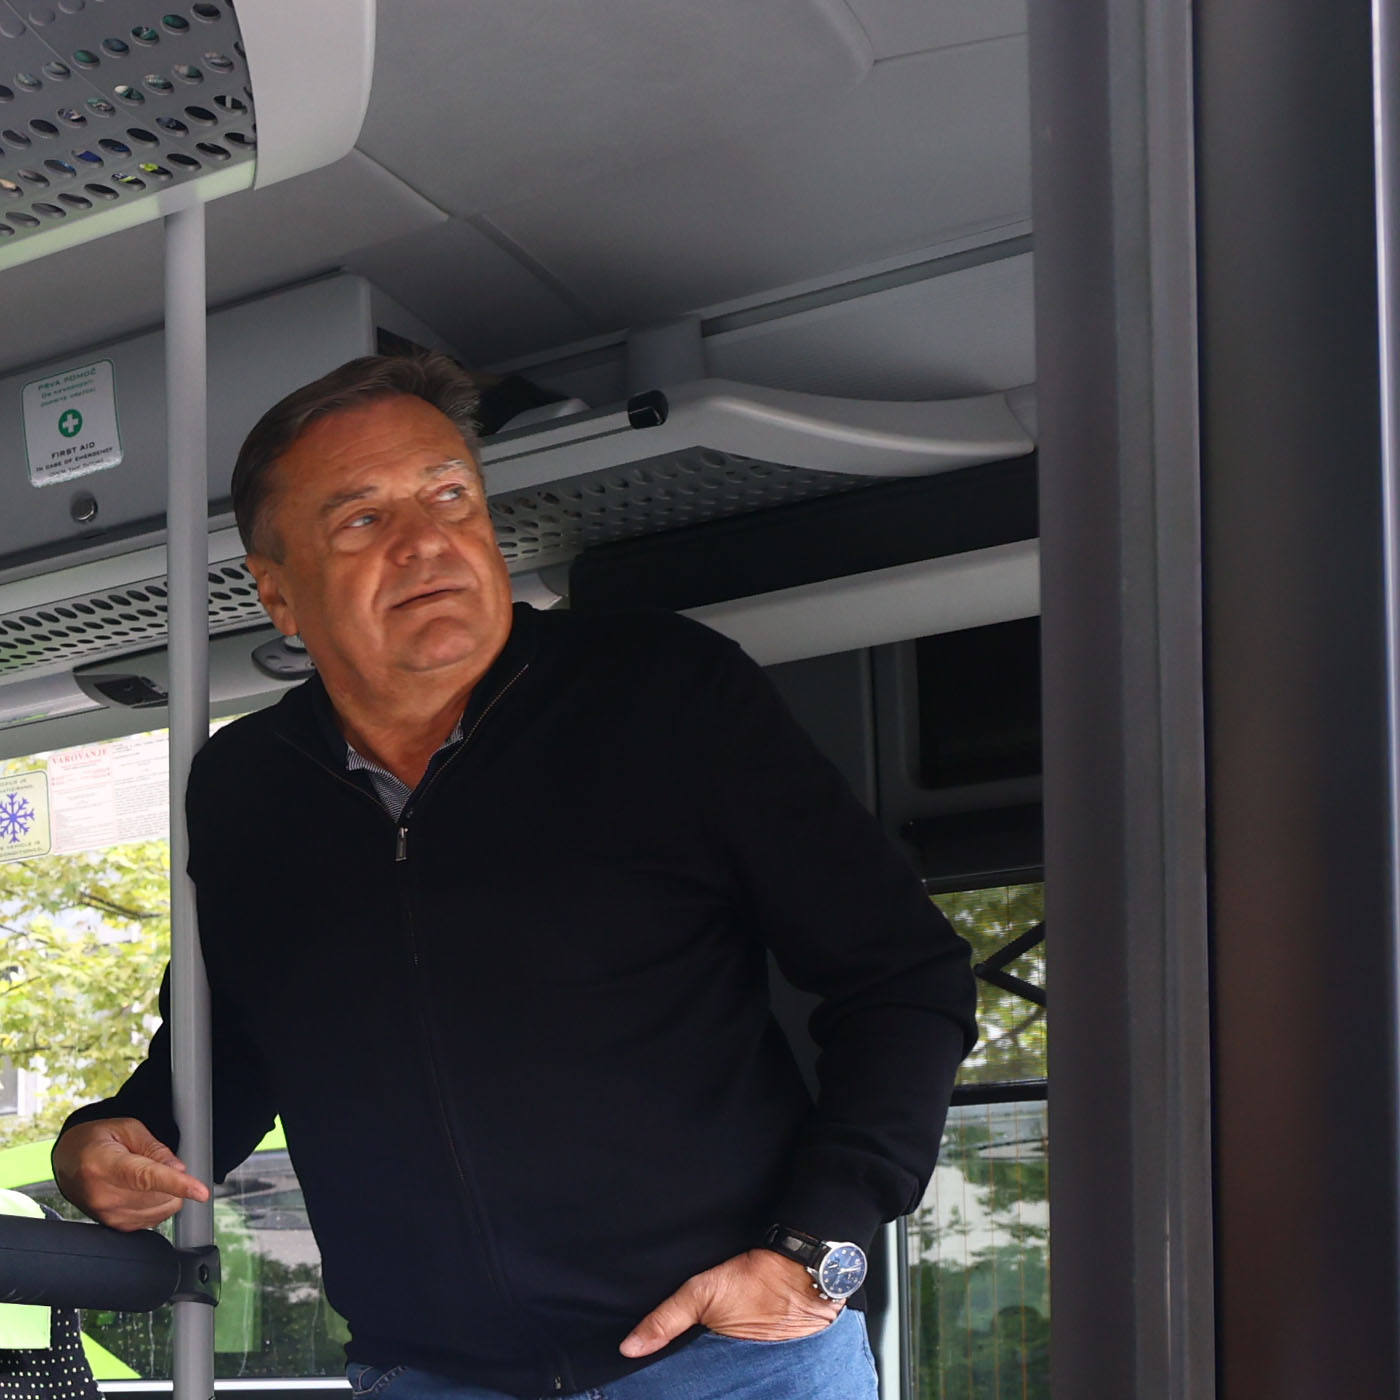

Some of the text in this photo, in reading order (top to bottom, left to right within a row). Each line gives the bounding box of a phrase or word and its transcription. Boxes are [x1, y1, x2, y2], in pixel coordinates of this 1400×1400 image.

[51, 441, 96, 459] FIRST AID
[51, 748, 108, 766] VAROVANJE
